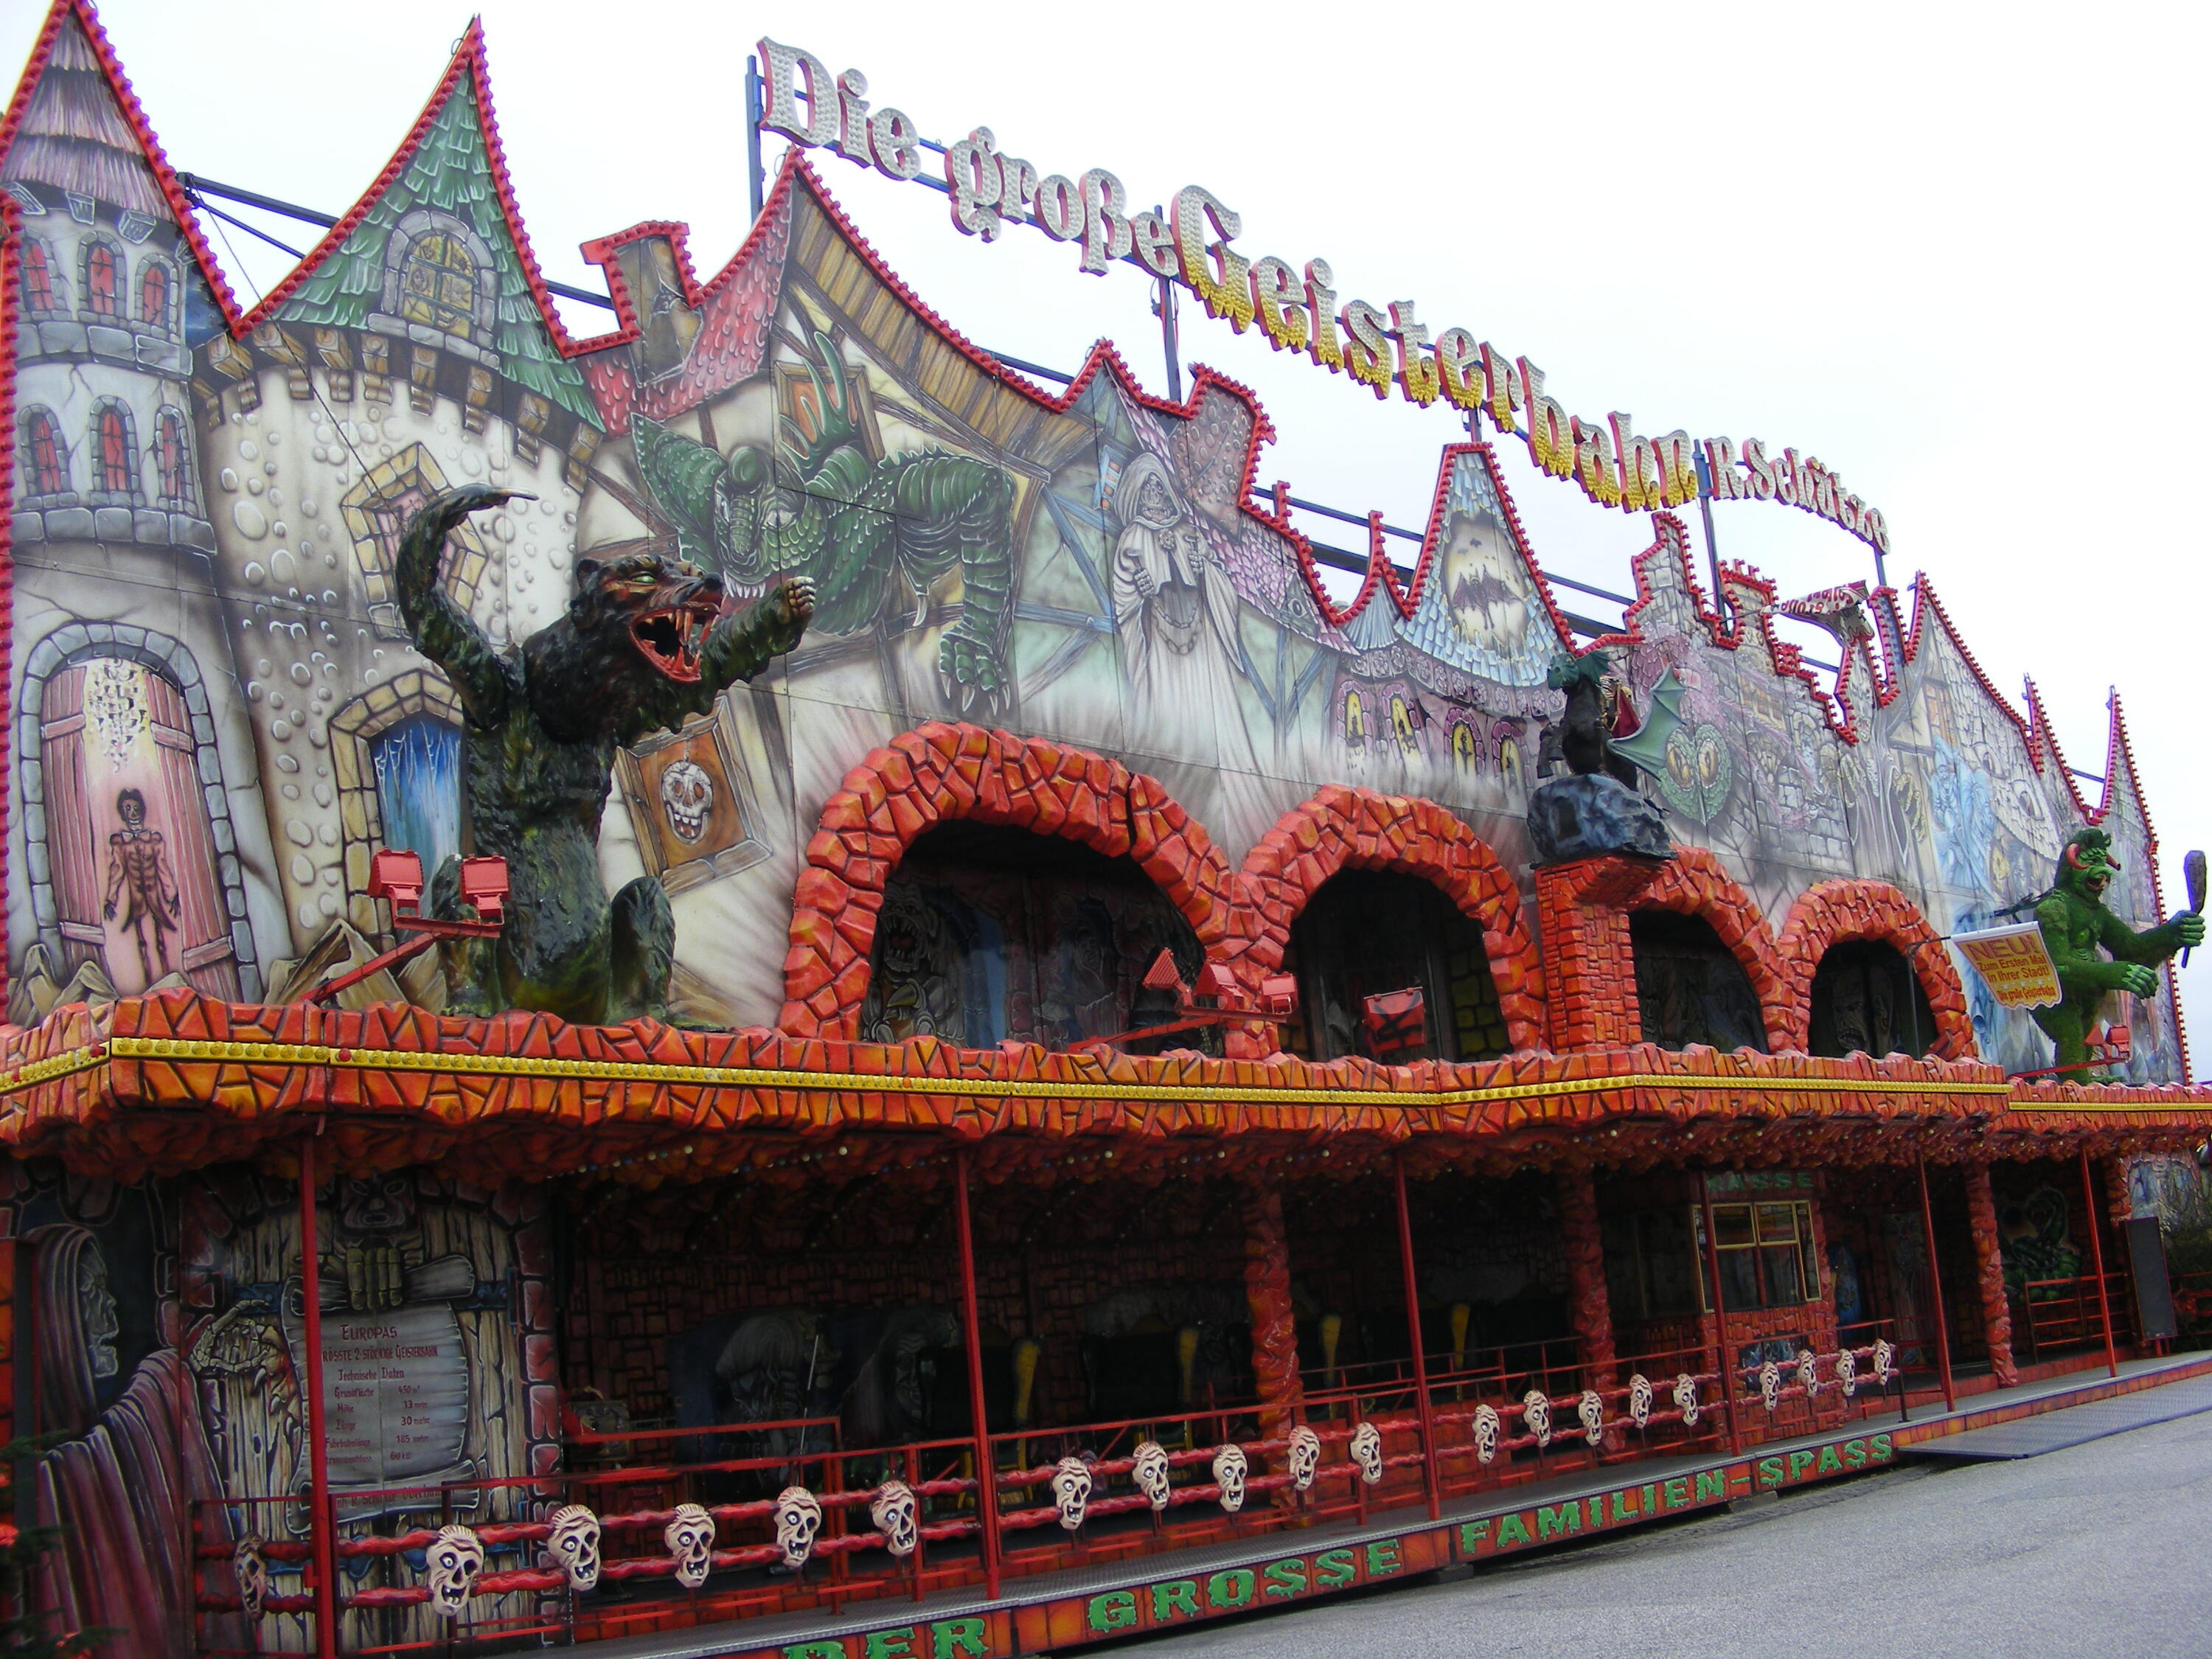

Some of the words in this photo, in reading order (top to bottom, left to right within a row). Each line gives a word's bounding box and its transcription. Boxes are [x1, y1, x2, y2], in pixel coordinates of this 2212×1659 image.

[757, 35, 922, 181] Die
[1170, 184, 1697, 514] Geisterbahn
[1966, 934, 2041, 961] NEU!
[1977, 961, 1999, 972] Zum
[1999, 958, 2028, 969] Ersten
[2029, 954, 2047, 965] Mal
[1986, 972, 1997, 983] in
[1997, 969, 2020, 981] Ihrer
[2020, 964, 2050, 978] Stadt!
[1707, 1172, 1813, 1192] KASSE
[322, 1347, 352, 1363] RÖSSTE
[401, 1416, 412, 1426] 30
[1088, 1538, 1402, 1632] GROSSE
